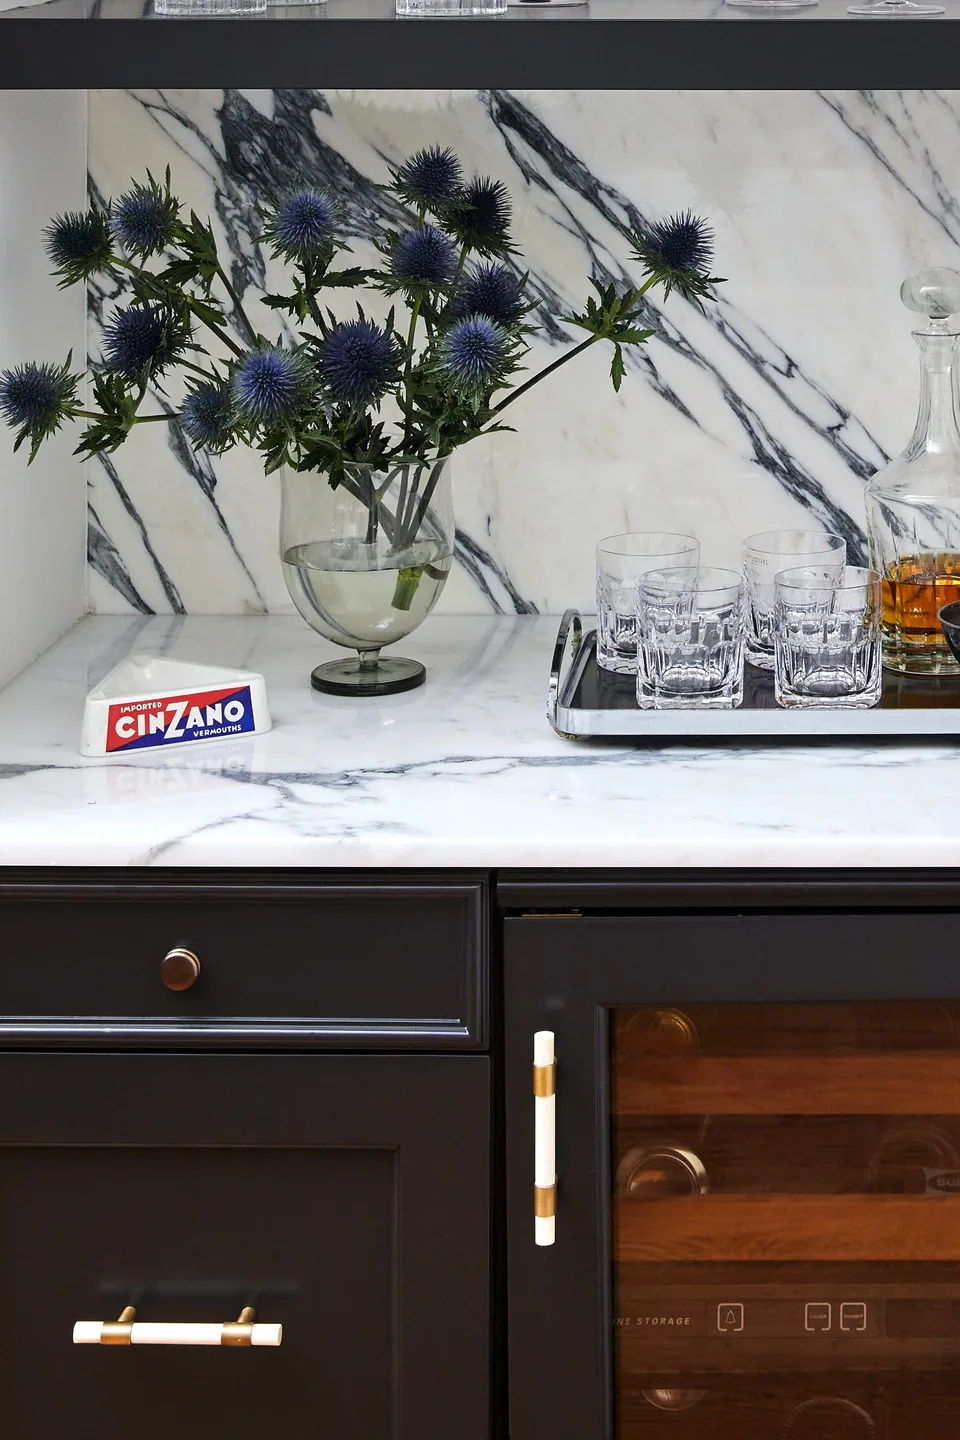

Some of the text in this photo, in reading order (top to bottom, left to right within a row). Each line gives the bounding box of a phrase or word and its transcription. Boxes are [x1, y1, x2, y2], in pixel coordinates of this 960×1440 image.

[120, 702, 162, 713] IMPORTED
[115, 700, 245, 739] CINZANO
[193, 725, 242, 737] VERMOUTHS
[612, 1317, 691, 1326] INE STORAGE
